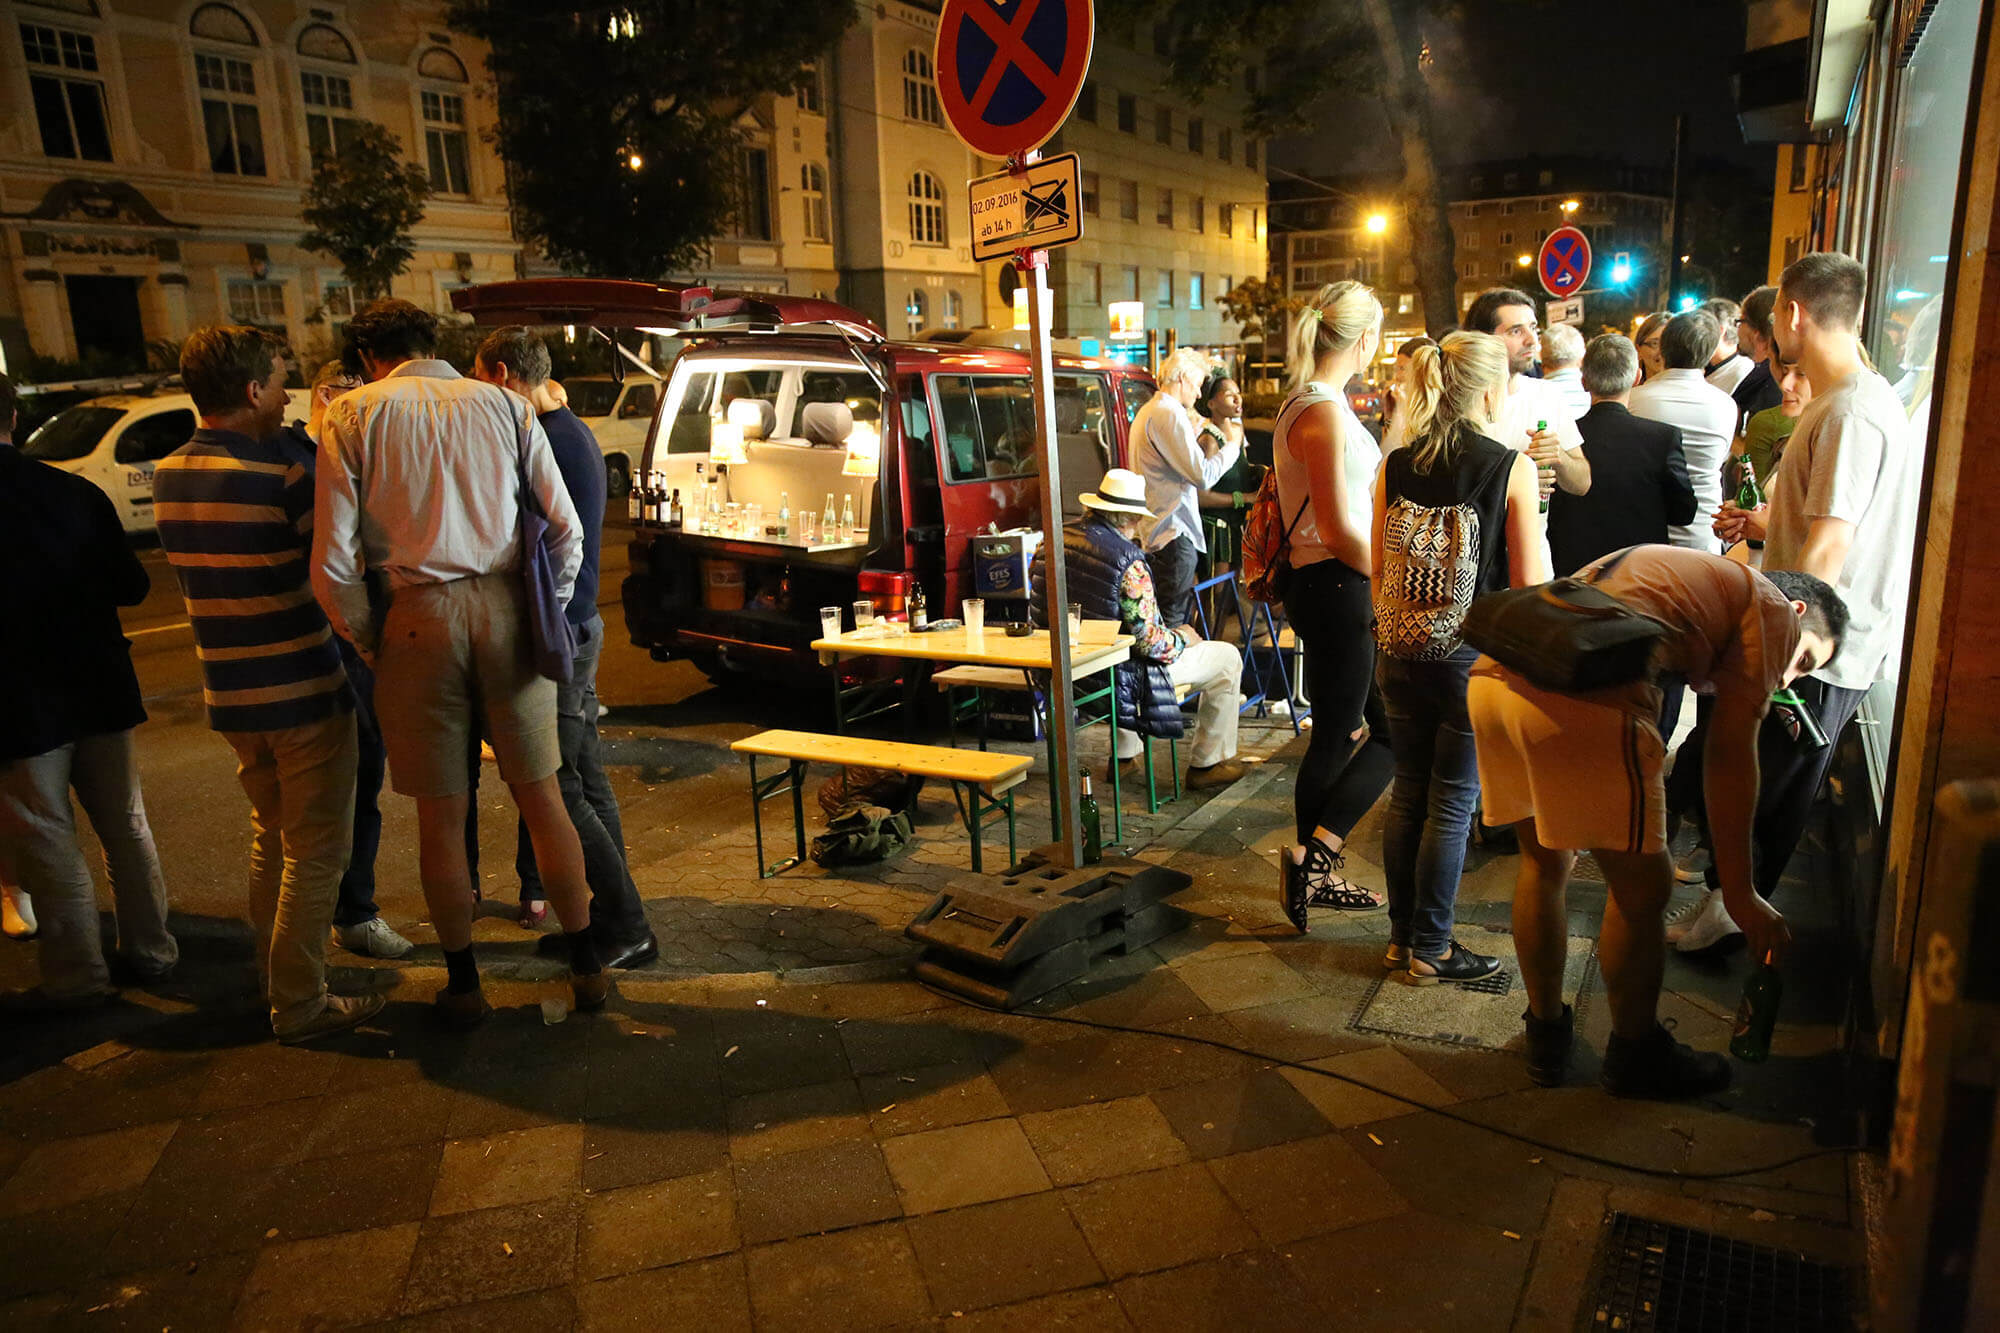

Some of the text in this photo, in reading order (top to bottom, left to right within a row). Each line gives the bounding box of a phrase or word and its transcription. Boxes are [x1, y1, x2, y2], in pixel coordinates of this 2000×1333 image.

[972, 192, 1018, 215] 02.09.2016
[982, 218, 1012, 236] ab 14 h
